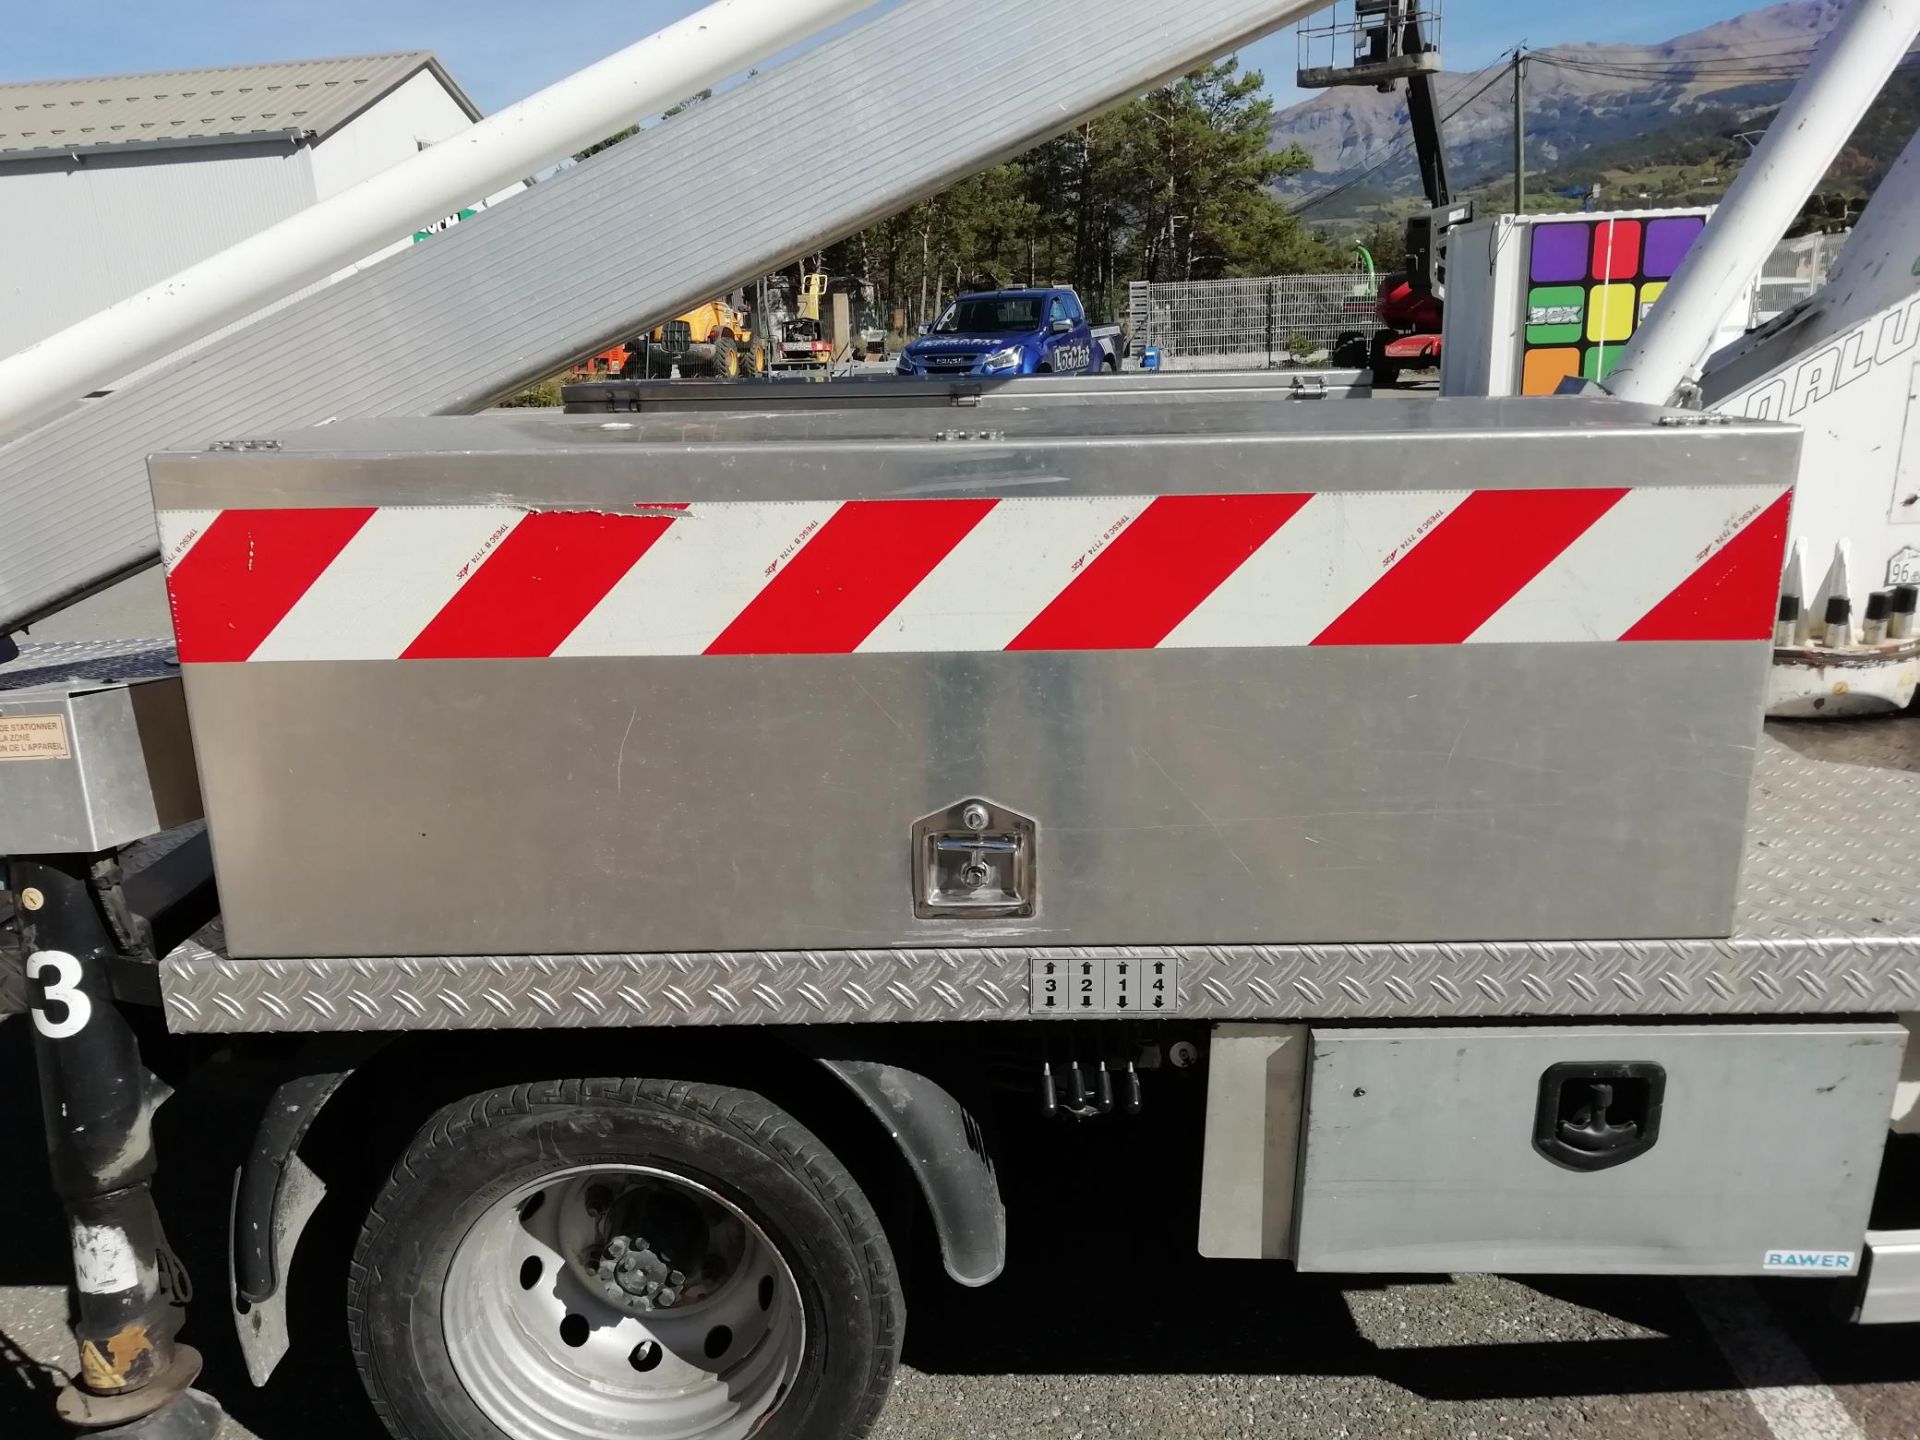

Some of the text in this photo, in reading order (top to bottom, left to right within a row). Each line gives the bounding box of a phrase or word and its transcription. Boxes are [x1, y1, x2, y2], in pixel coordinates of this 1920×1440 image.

[1108, 514, 1130, 535] TPESC
[1422, 509, 1444, 529] TPESC
[489, 524, 509, 544] TPESC
[798, 520, 819, 540] TPESC
[1088, 540, 1104, 555] 7174
[1892, 563, 1910, 583] 96
[11, 722, 58, 732] STATIONNER
[10, 733, 31, 741] ZONE
[9, 743, 20, 751] DE
[21, 742, 64, 751] L'APPAREIL
[26, 950, 91, 1038] 3
[1045, 979, 1164, 992] 3 2 1 4
[1769, 1254, 1850, 1268] BAWER
